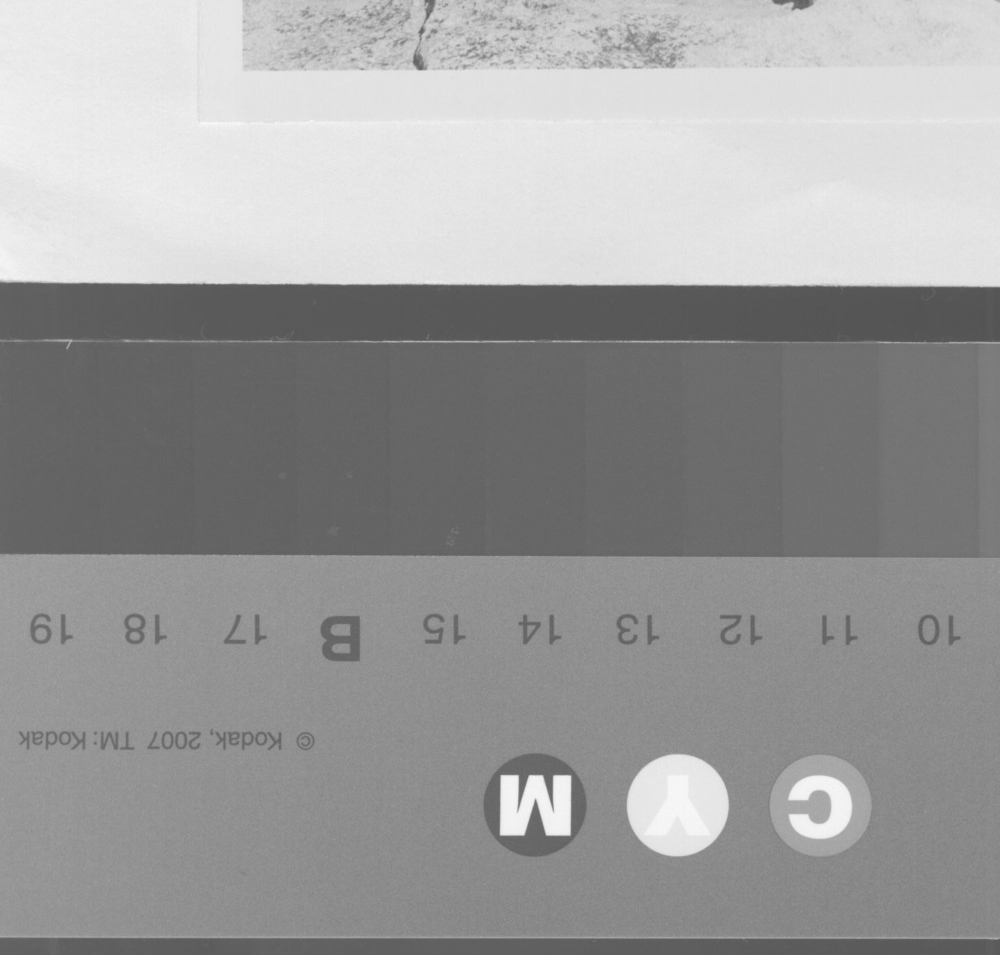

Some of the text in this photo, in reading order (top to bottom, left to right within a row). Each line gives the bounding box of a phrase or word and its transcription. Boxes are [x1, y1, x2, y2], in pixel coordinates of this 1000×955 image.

[29, 612, 74, 645] 19
[123, 612, 168, 645] 18
[223, 613, 268, 646] 17
[319, 615, 361, 663] B
[422, 613, 467, 646] 15
[517, 613, 562, 646] 14
[615, 613, 660, 646] 13
[719, 614, 763, 646] 12
[821, 614, 859, 646] 11
[917, 614, 962, 646] 10
[18, 730, 87, 751] Kodak
[93, 731, 136, 751] TM:
[146, 730, 202, 751] 2007
[209, 728, 283, 751] Kodak,
[499, 774, 854, 840] C Y M
